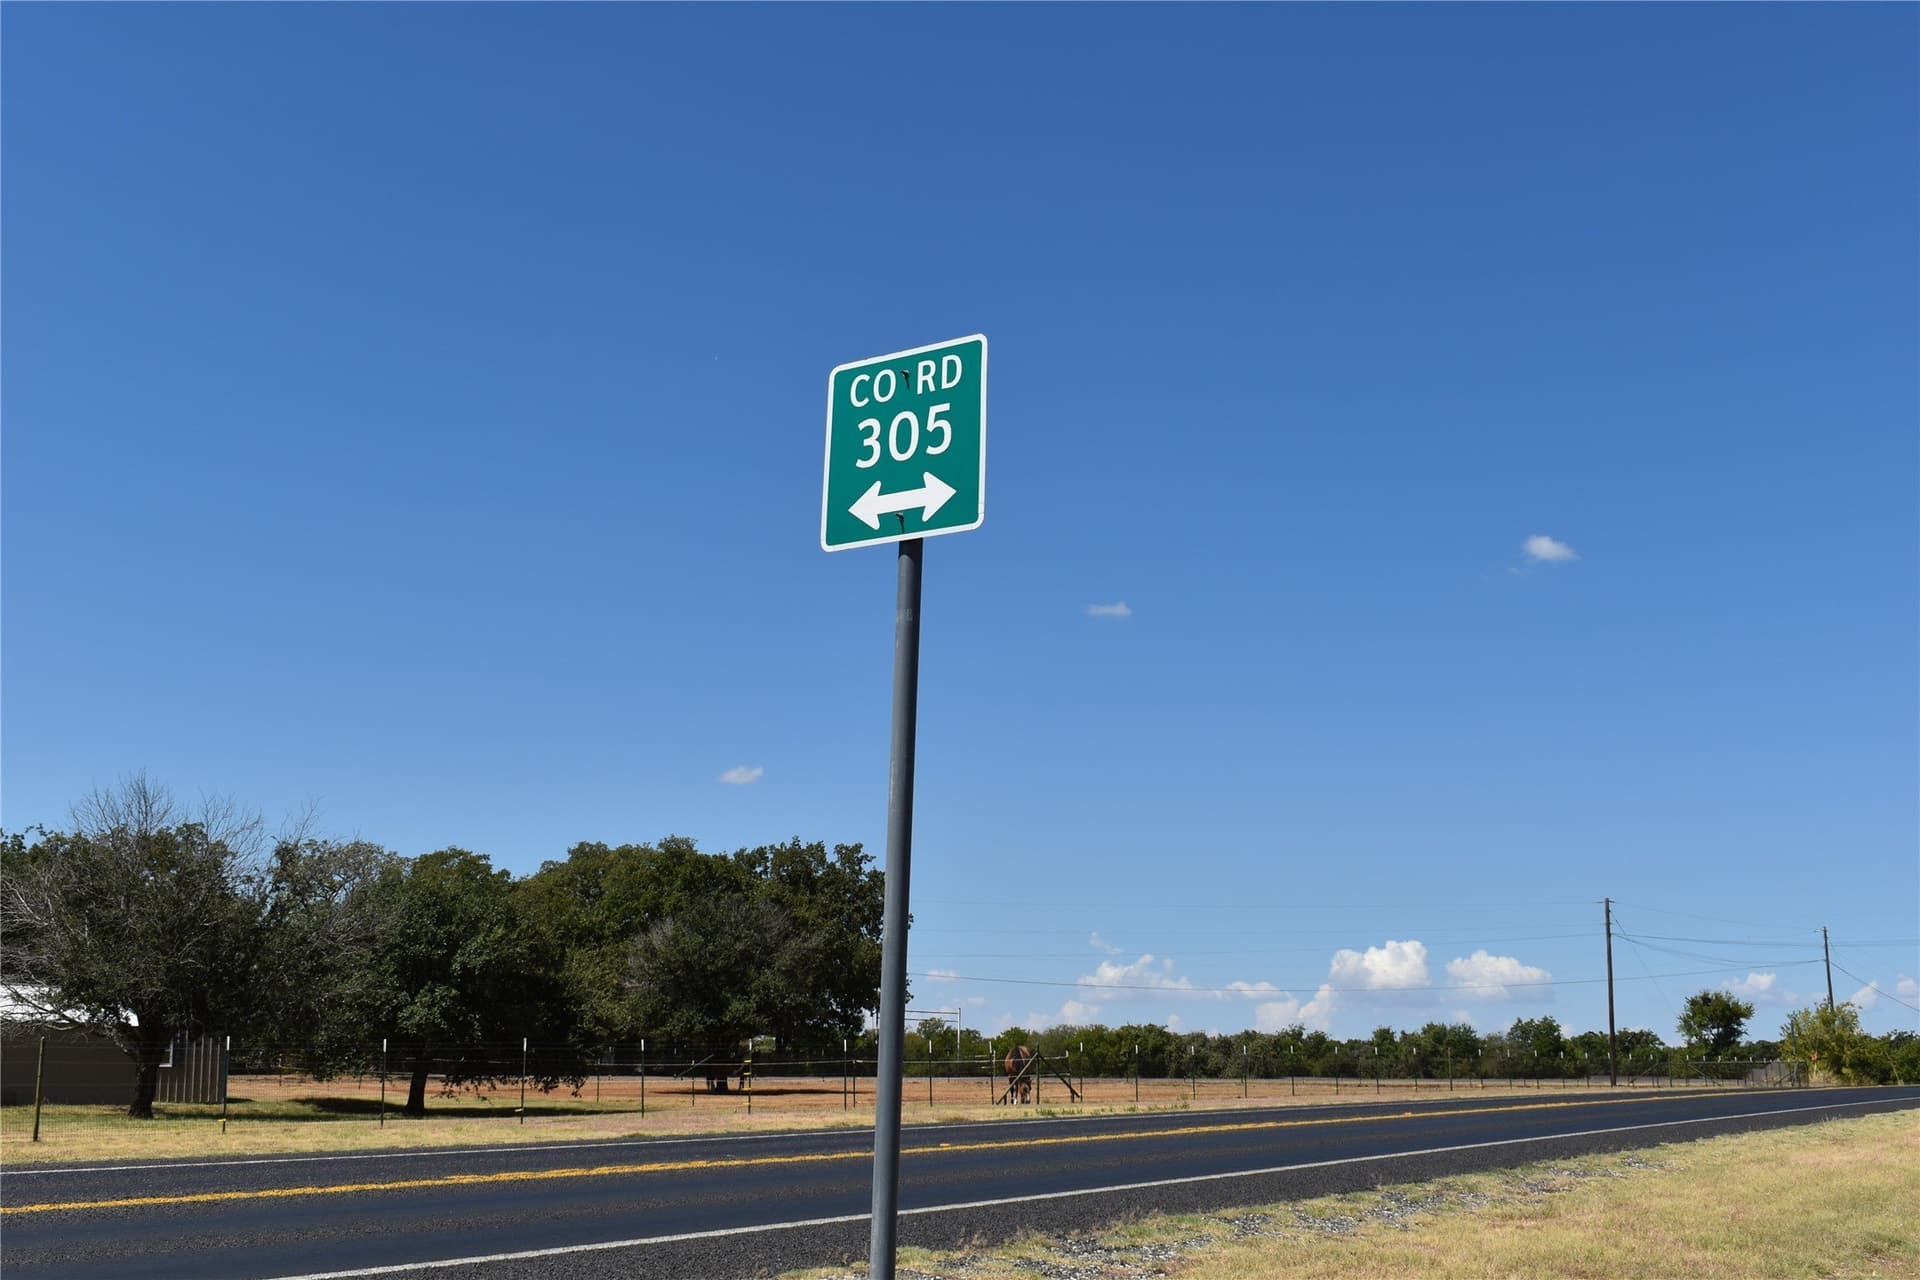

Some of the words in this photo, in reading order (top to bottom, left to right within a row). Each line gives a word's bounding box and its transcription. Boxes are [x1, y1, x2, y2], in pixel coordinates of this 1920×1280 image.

[850, 368, 897, 408] CO
[917, 354, 963, 395] RD
[855, 402, 952, 469] 305
